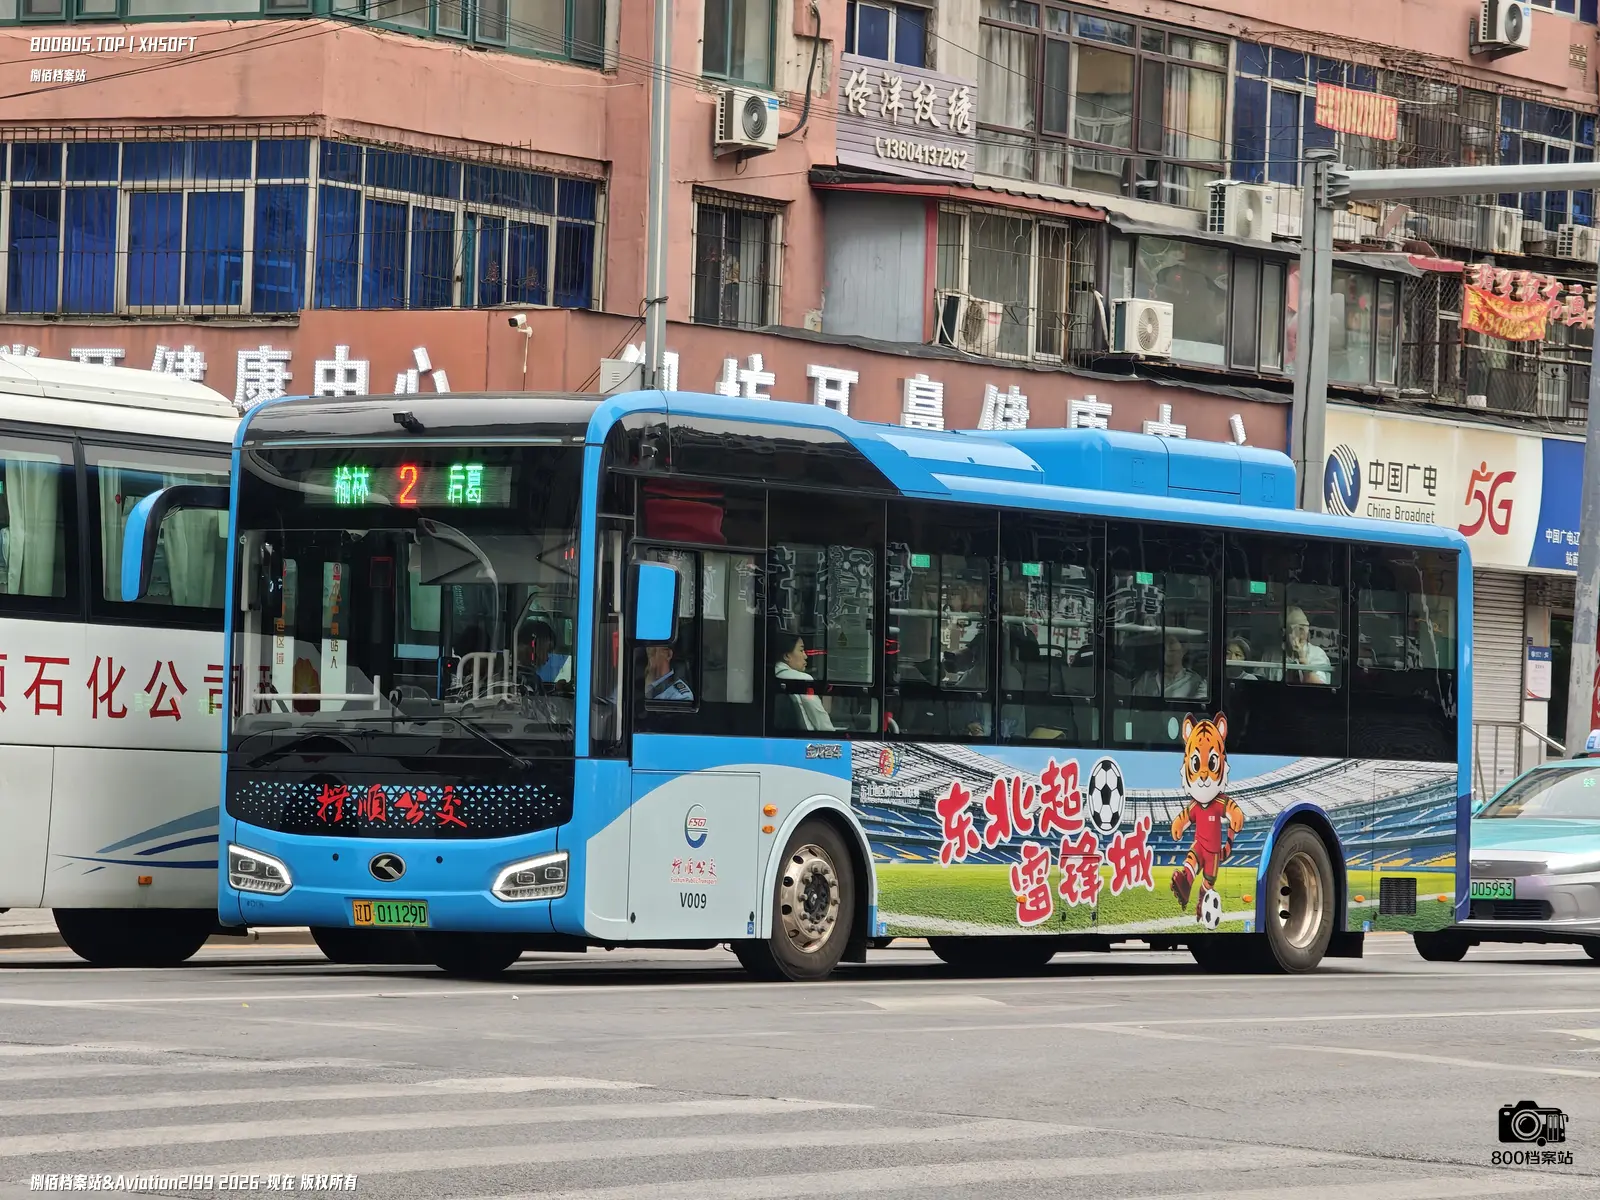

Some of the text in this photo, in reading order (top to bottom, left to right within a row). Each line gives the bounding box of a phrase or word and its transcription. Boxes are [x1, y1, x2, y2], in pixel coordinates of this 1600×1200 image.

[884, 138, 968, 171] 13604137262
[334, 466, 369, 504] 榆林
[400, 466, 417, 504] 2
[1369, 459, 1437, 497] 中国广电
[1367, 503, 1435, 524] China Broadnet
[1458, 461, 1517, 537] 5G
[937, 756, 1084, 868] 东北超
[1009, 815, 1154, 926] 雷锋城
[376, 903, 427, 924] 01129D
[680, 892, 707, 909] V009
